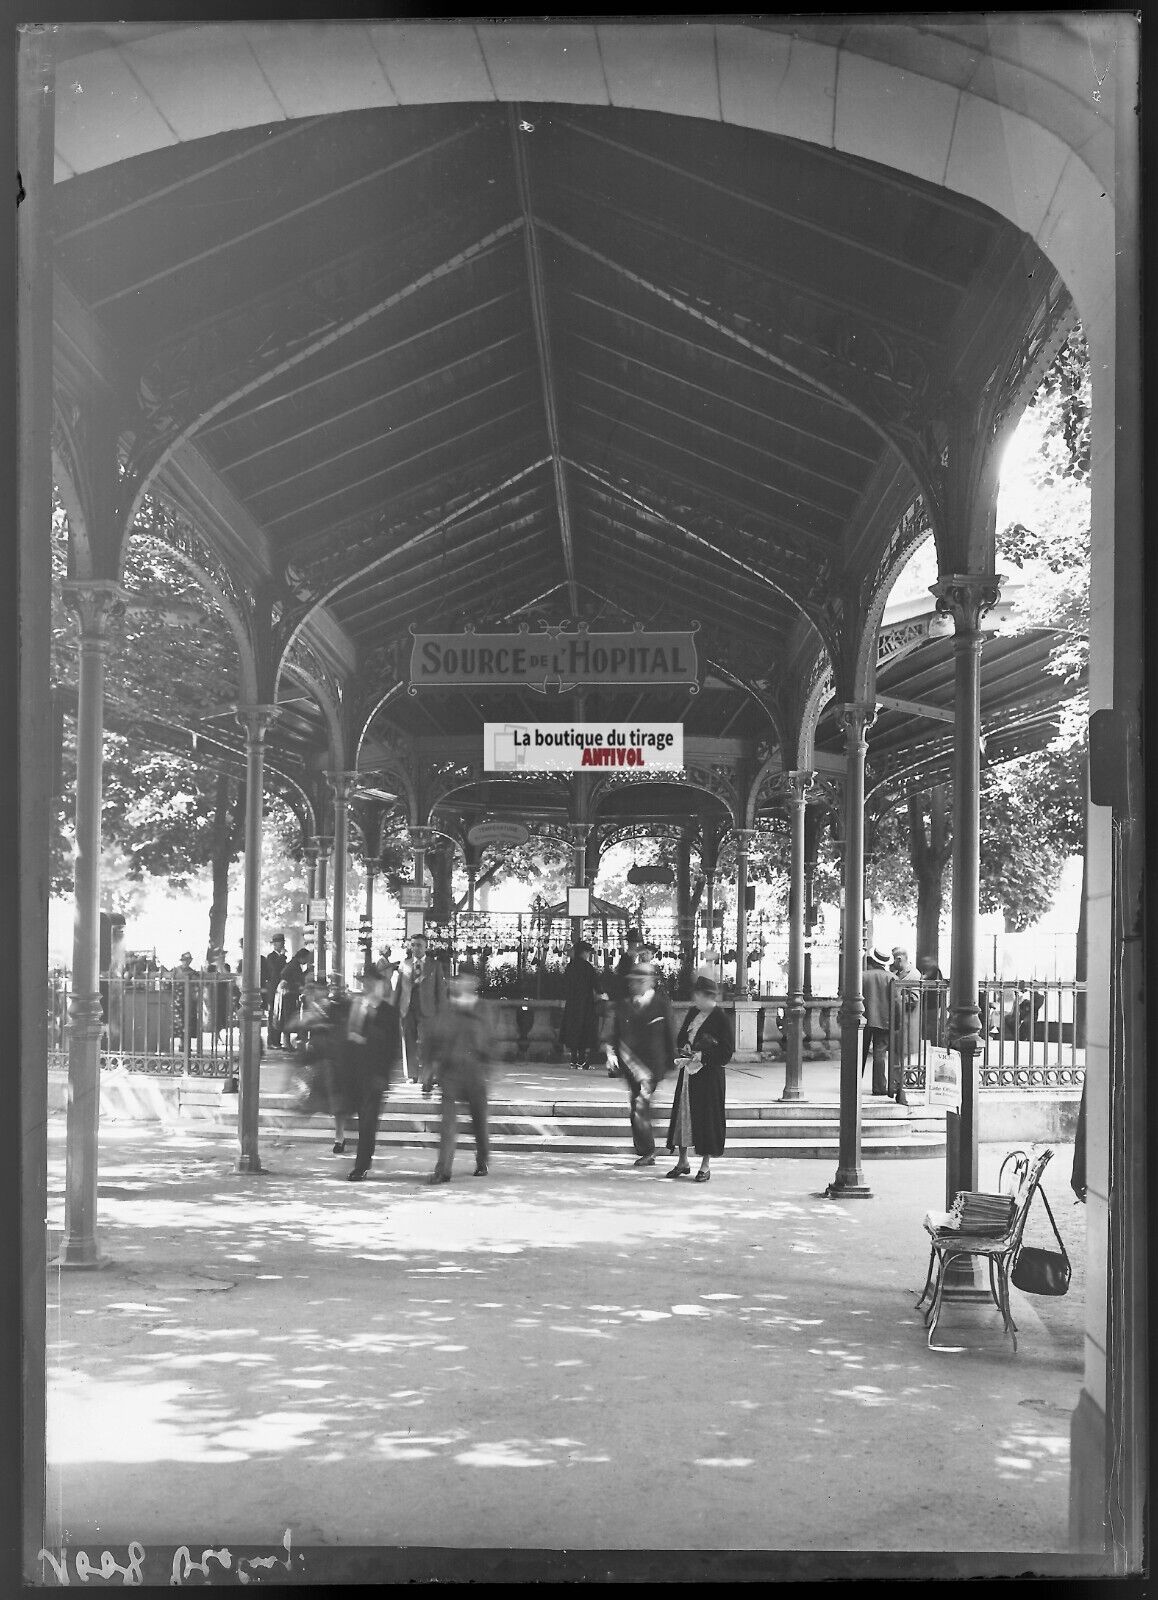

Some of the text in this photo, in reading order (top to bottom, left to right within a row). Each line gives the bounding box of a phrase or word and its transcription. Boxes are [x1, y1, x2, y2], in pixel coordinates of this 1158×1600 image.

[422, 640, 687, 674] SOURCE DE L'HOPITAL
